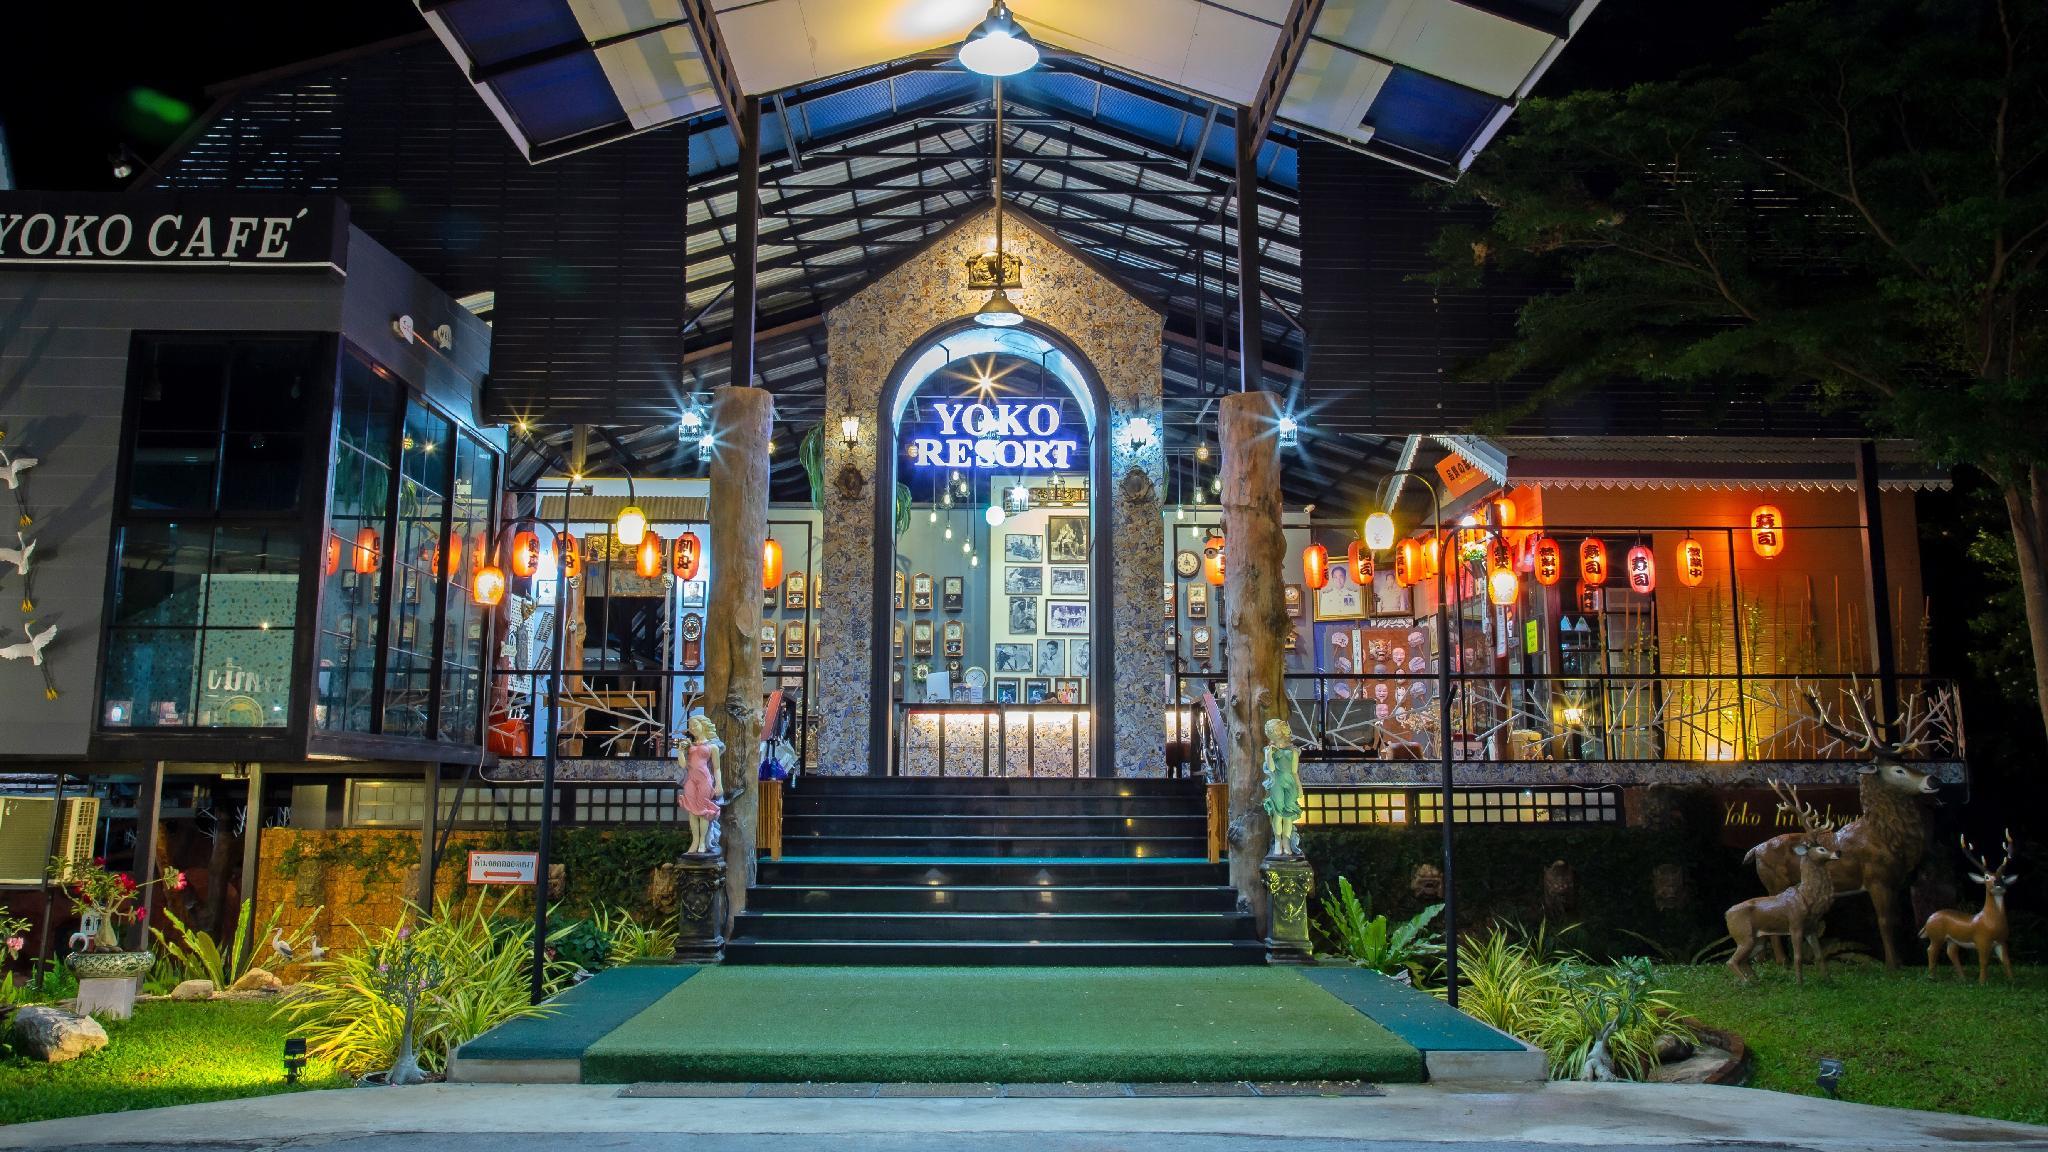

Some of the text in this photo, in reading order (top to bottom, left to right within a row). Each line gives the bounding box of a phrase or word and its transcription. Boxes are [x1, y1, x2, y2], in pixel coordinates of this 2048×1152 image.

[933, 402, 1060, 437] YOKO
[914, 438, 1077, 469] RESORT
[1724, 801, 1761, 827] Yoko
